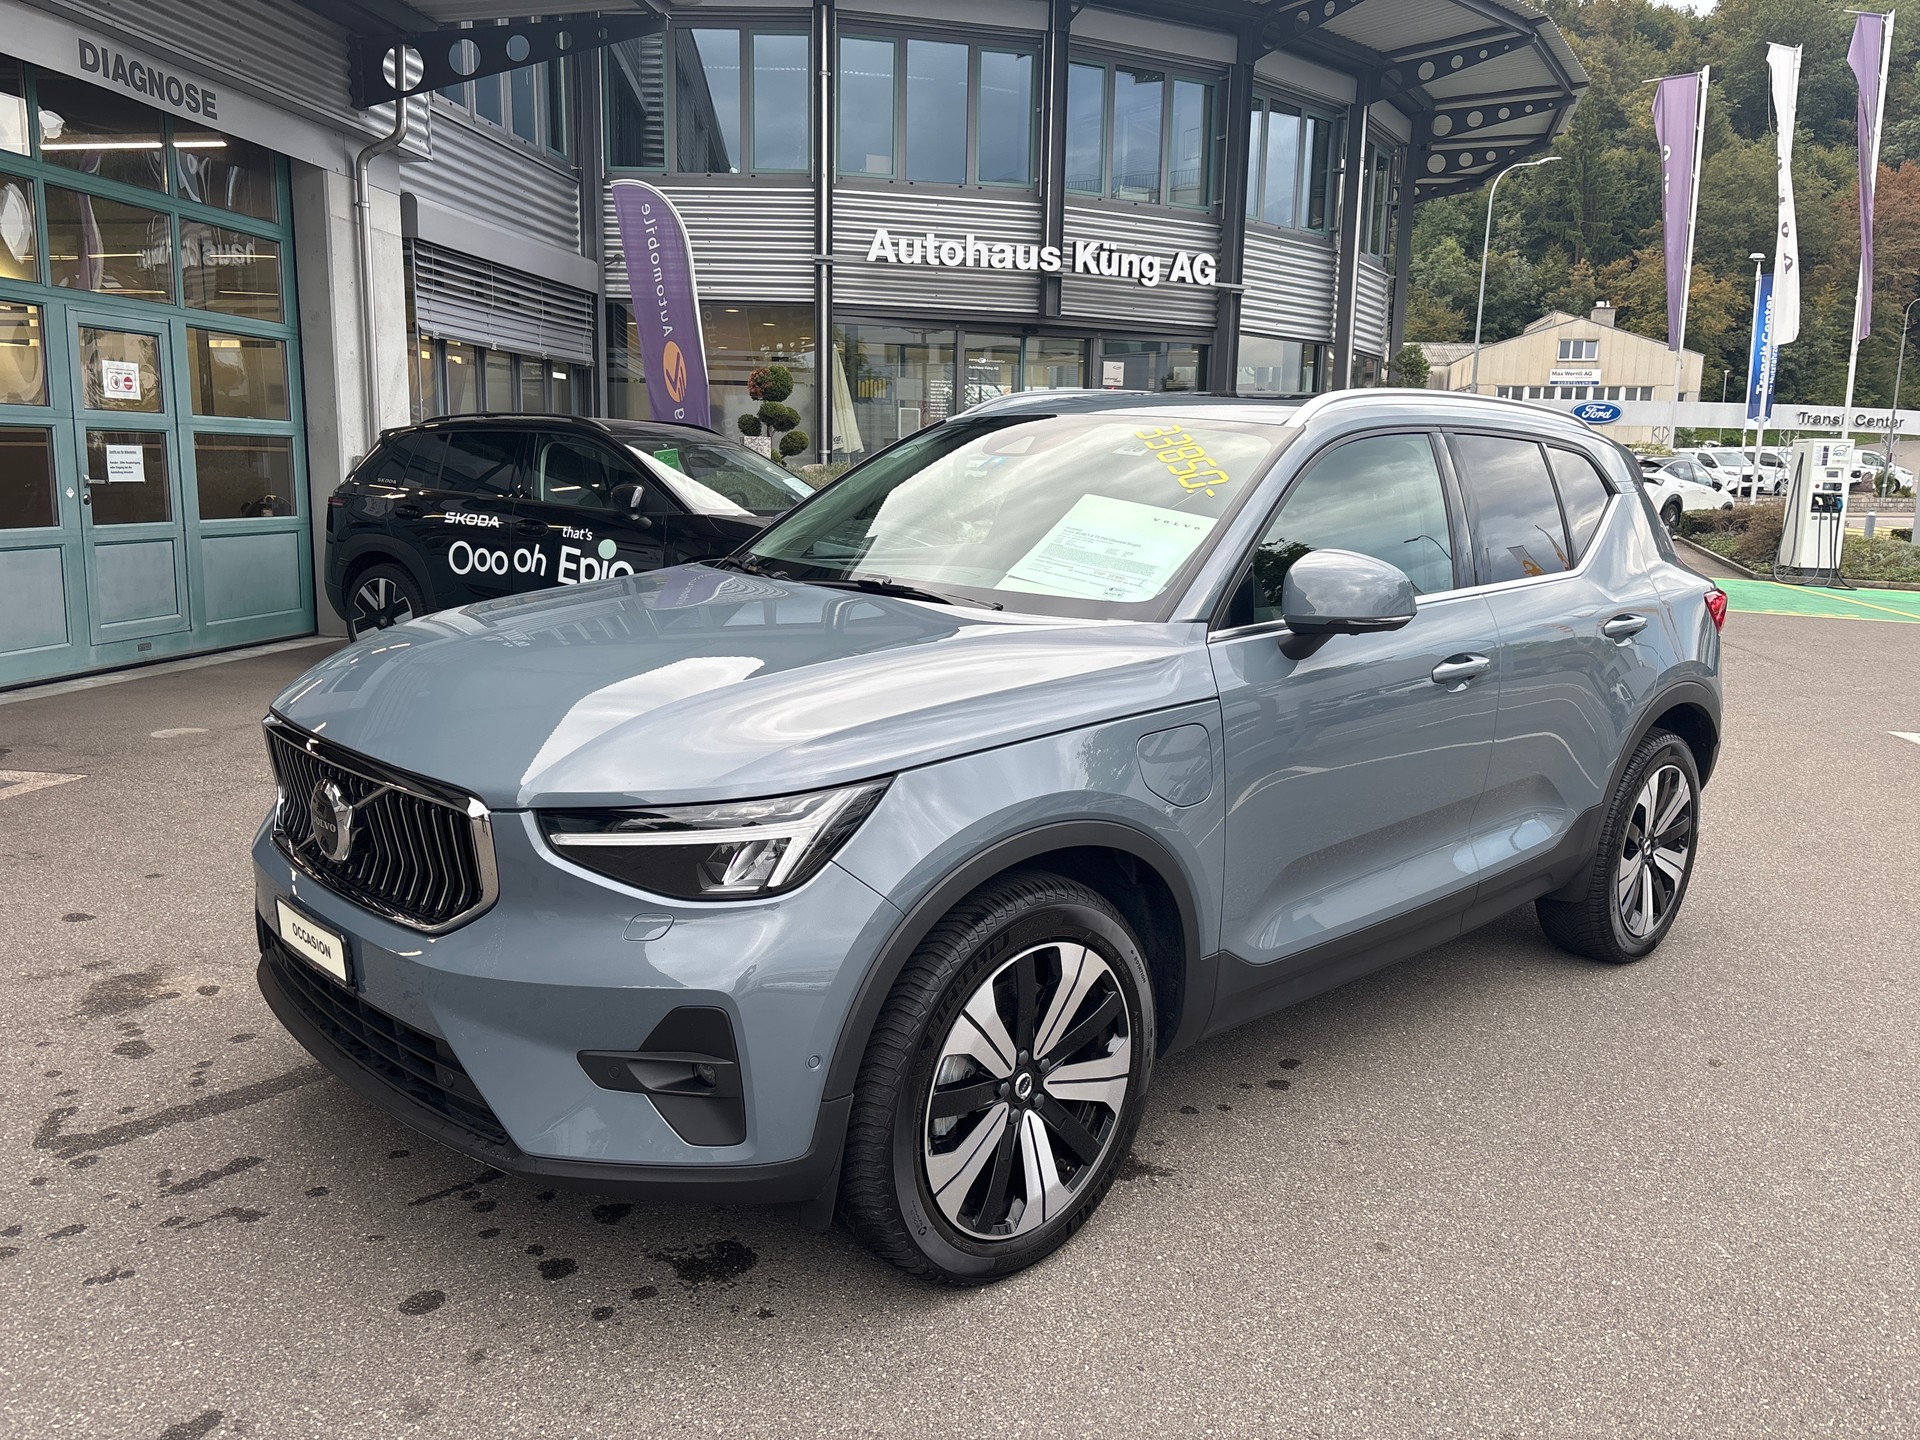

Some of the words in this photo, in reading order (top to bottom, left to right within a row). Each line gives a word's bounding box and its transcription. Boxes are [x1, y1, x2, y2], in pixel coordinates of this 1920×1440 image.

[78, 38, 218, 120] DIAGNOSE
[866, 228, 1062, 272] Autohaus
[1074, 240, 1161, 287] Küng
[1167, 251, 1217, 286] AG
[1582, 404, 1613, 418] Ford
[1798, 411, 1846, 426] Transi
[562, 526, 593, 541] that's
[1153, 517, 1200, 531] VOLVO
[448, 540, 508, 575] Ooo
[514, 544, 547, 577] oh
[292, 922, 332, 959] OCCASION
